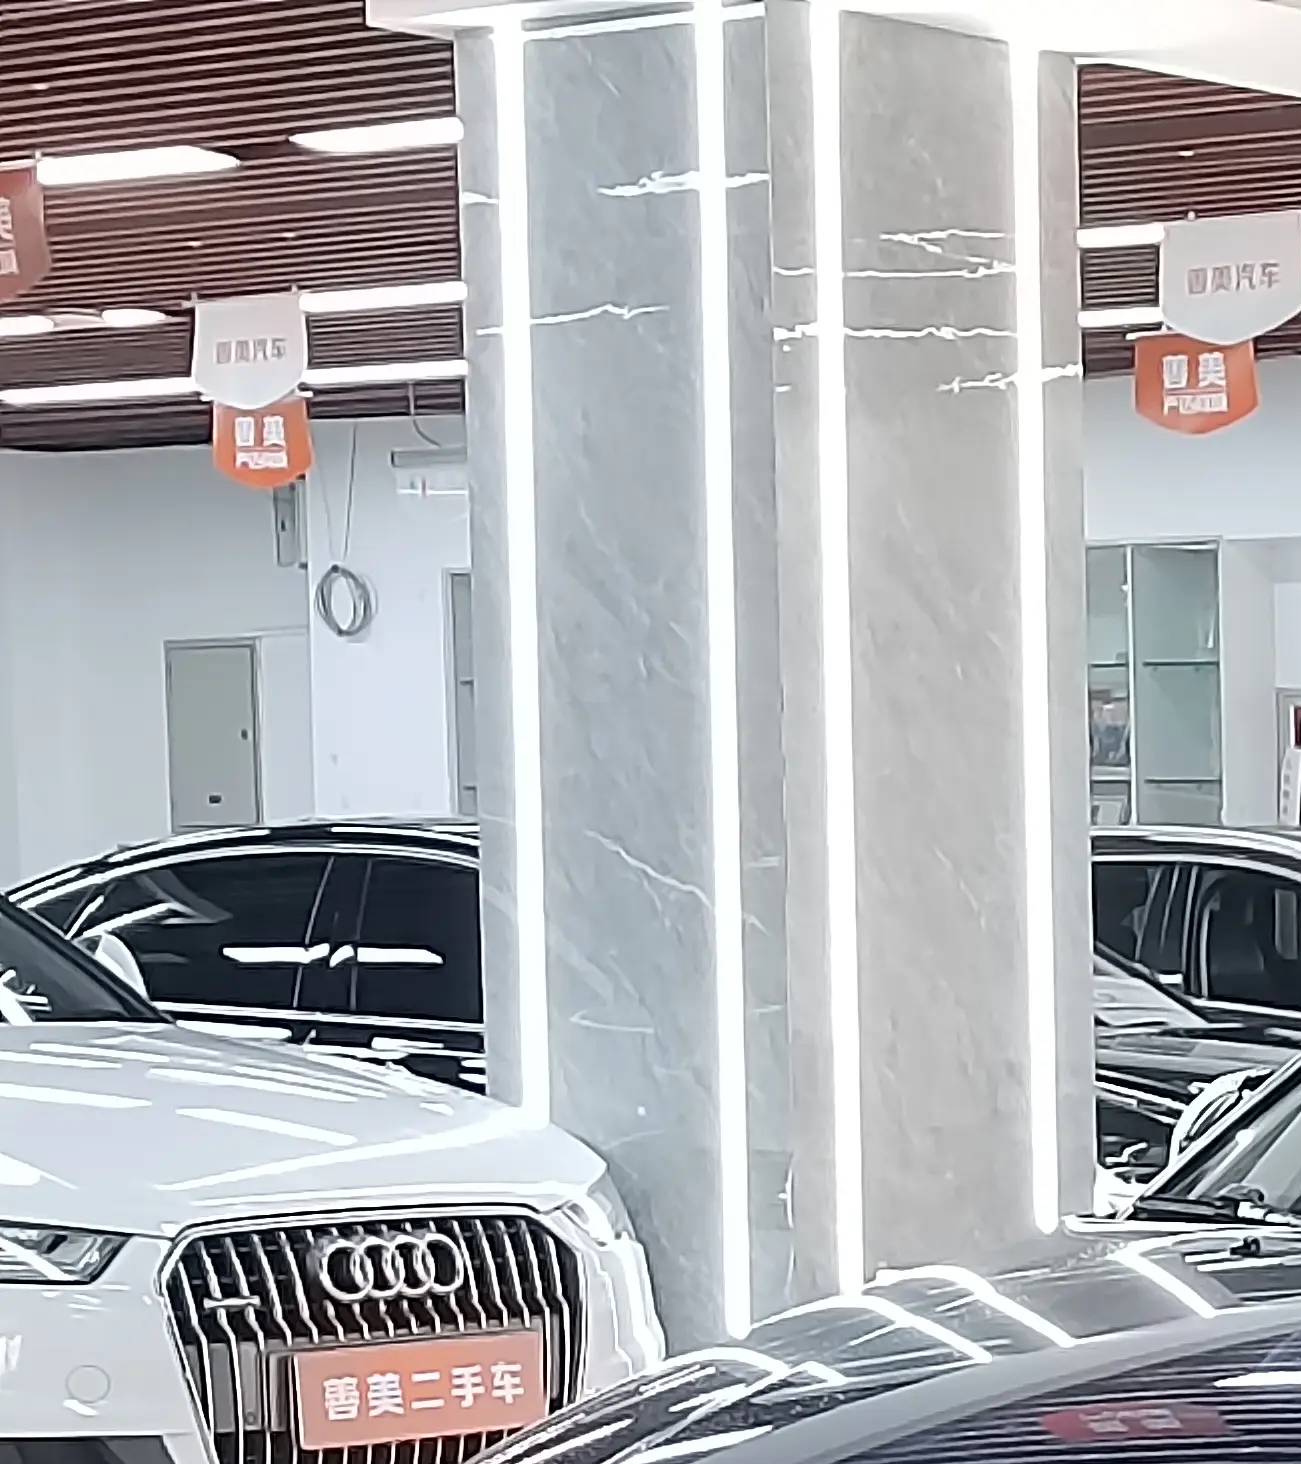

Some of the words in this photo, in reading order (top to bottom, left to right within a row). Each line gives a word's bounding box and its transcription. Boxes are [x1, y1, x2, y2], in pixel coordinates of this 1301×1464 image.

[322, 1361, 525, 1422] 善美二手车
